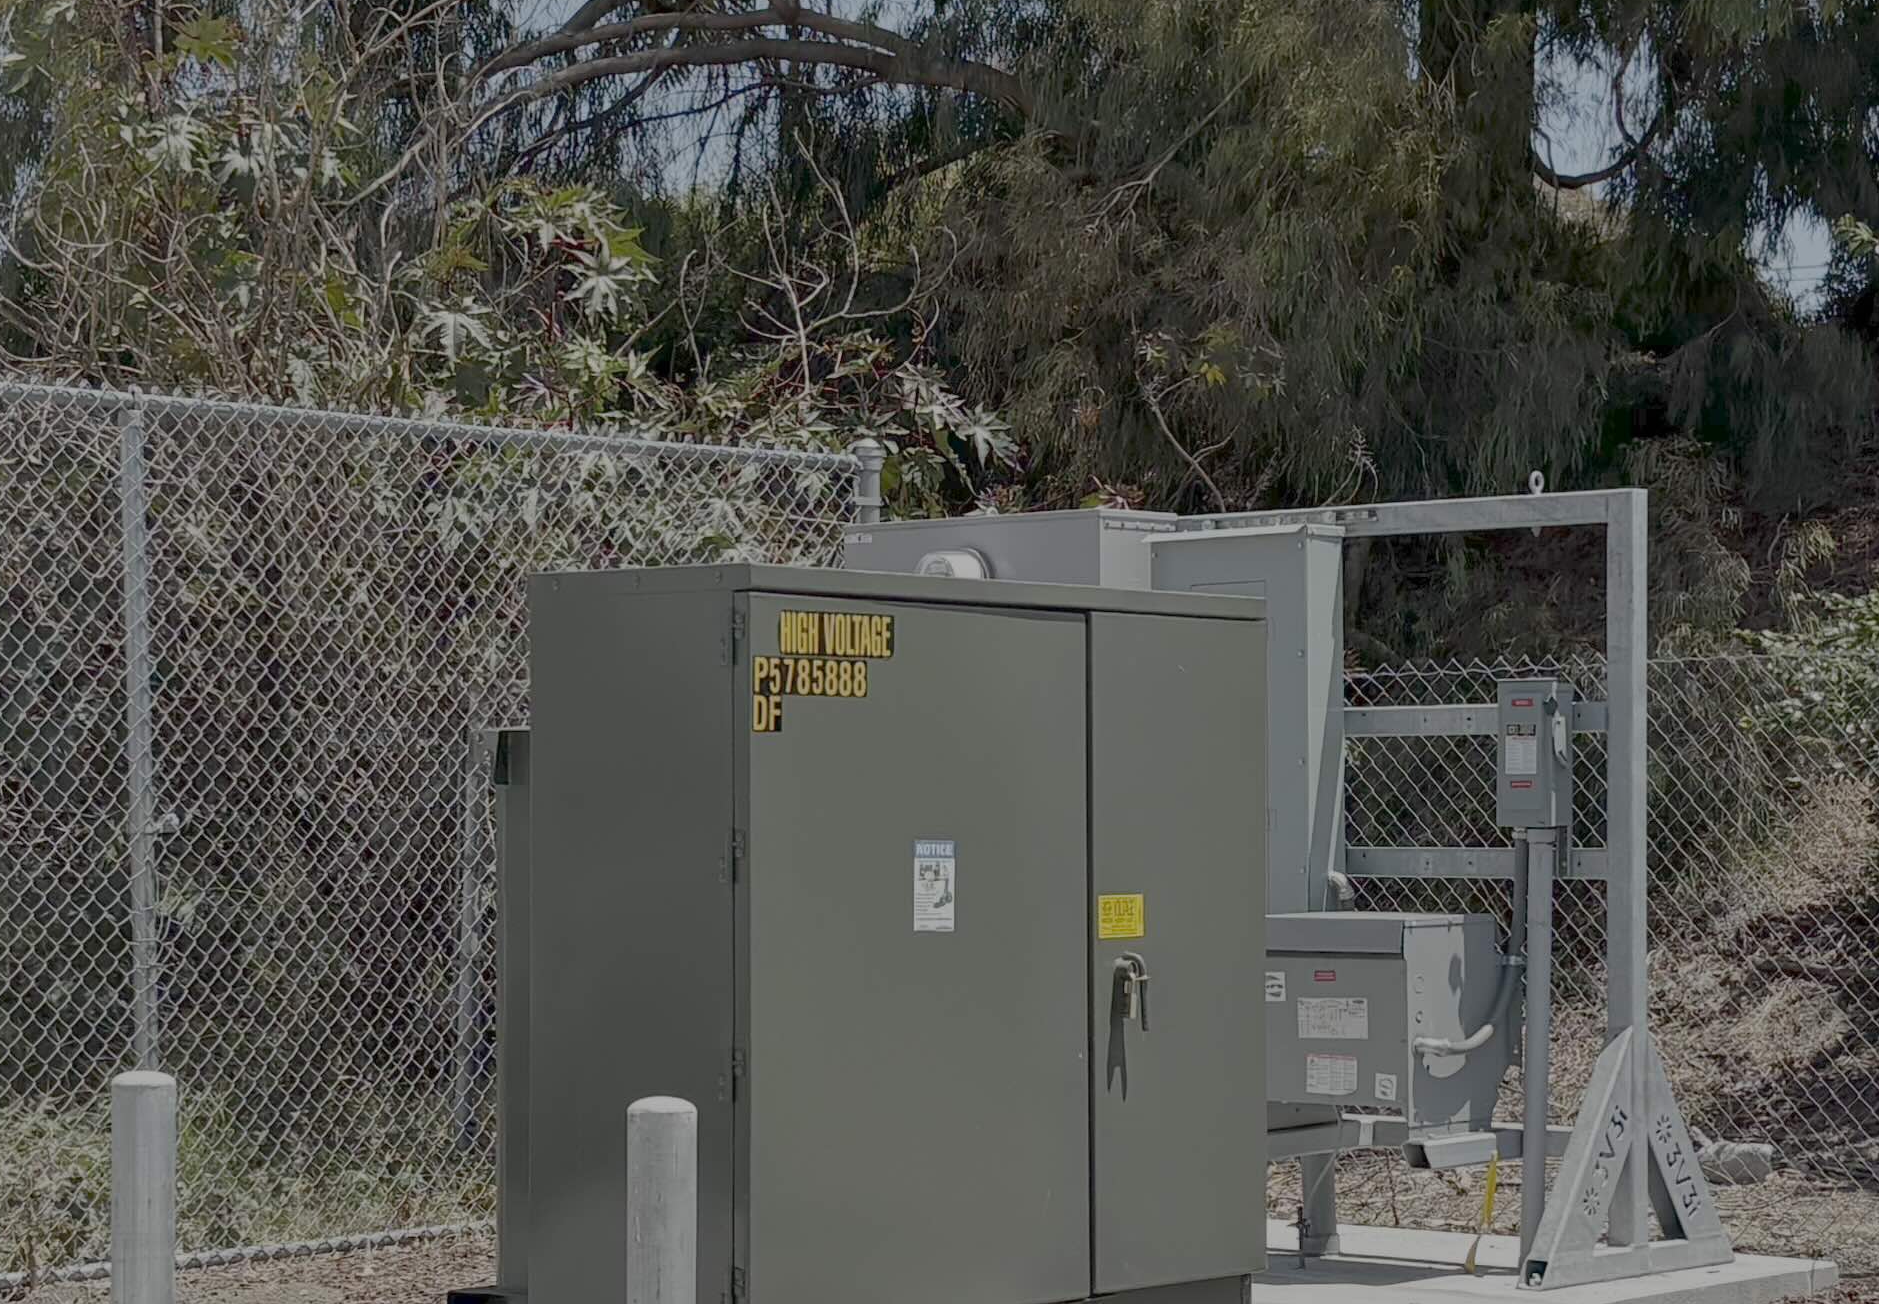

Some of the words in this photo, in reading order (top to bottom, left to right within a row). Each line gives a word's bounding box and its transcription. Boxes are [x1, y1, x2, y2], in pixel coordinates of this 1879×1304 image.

[780, 611, 820, 655] HIGH
[823, 613, 892, 657] VOLTAGE
[753, 656, 867, 697] P5785888
[752, 695, 782, 732] DF
[915, 843, 953, 857] NOTICE
